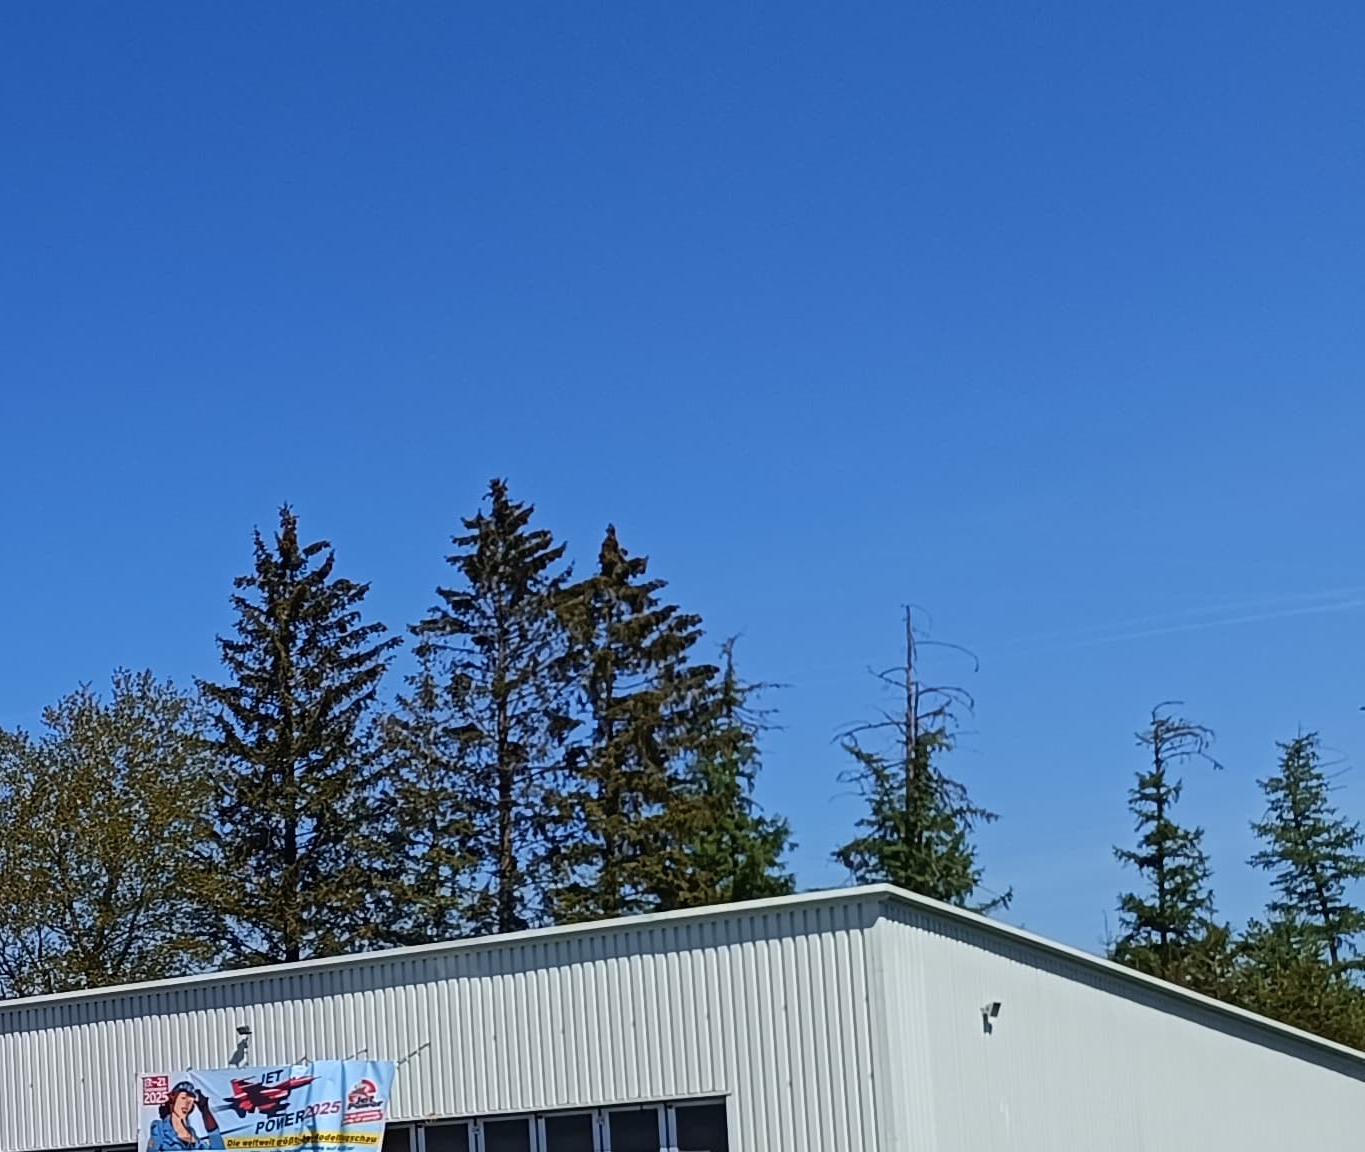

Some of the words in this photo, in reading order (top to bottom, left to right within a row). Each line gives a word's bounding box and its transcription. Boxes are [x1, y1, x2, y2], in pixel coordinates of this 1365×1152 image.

[261, 1069, 284, 1085] JET
[144, 1091, 170, 1104] 2025
[254, 1109, 305, 1135] POWER
[303, 1100, 342, 1119] 2025
